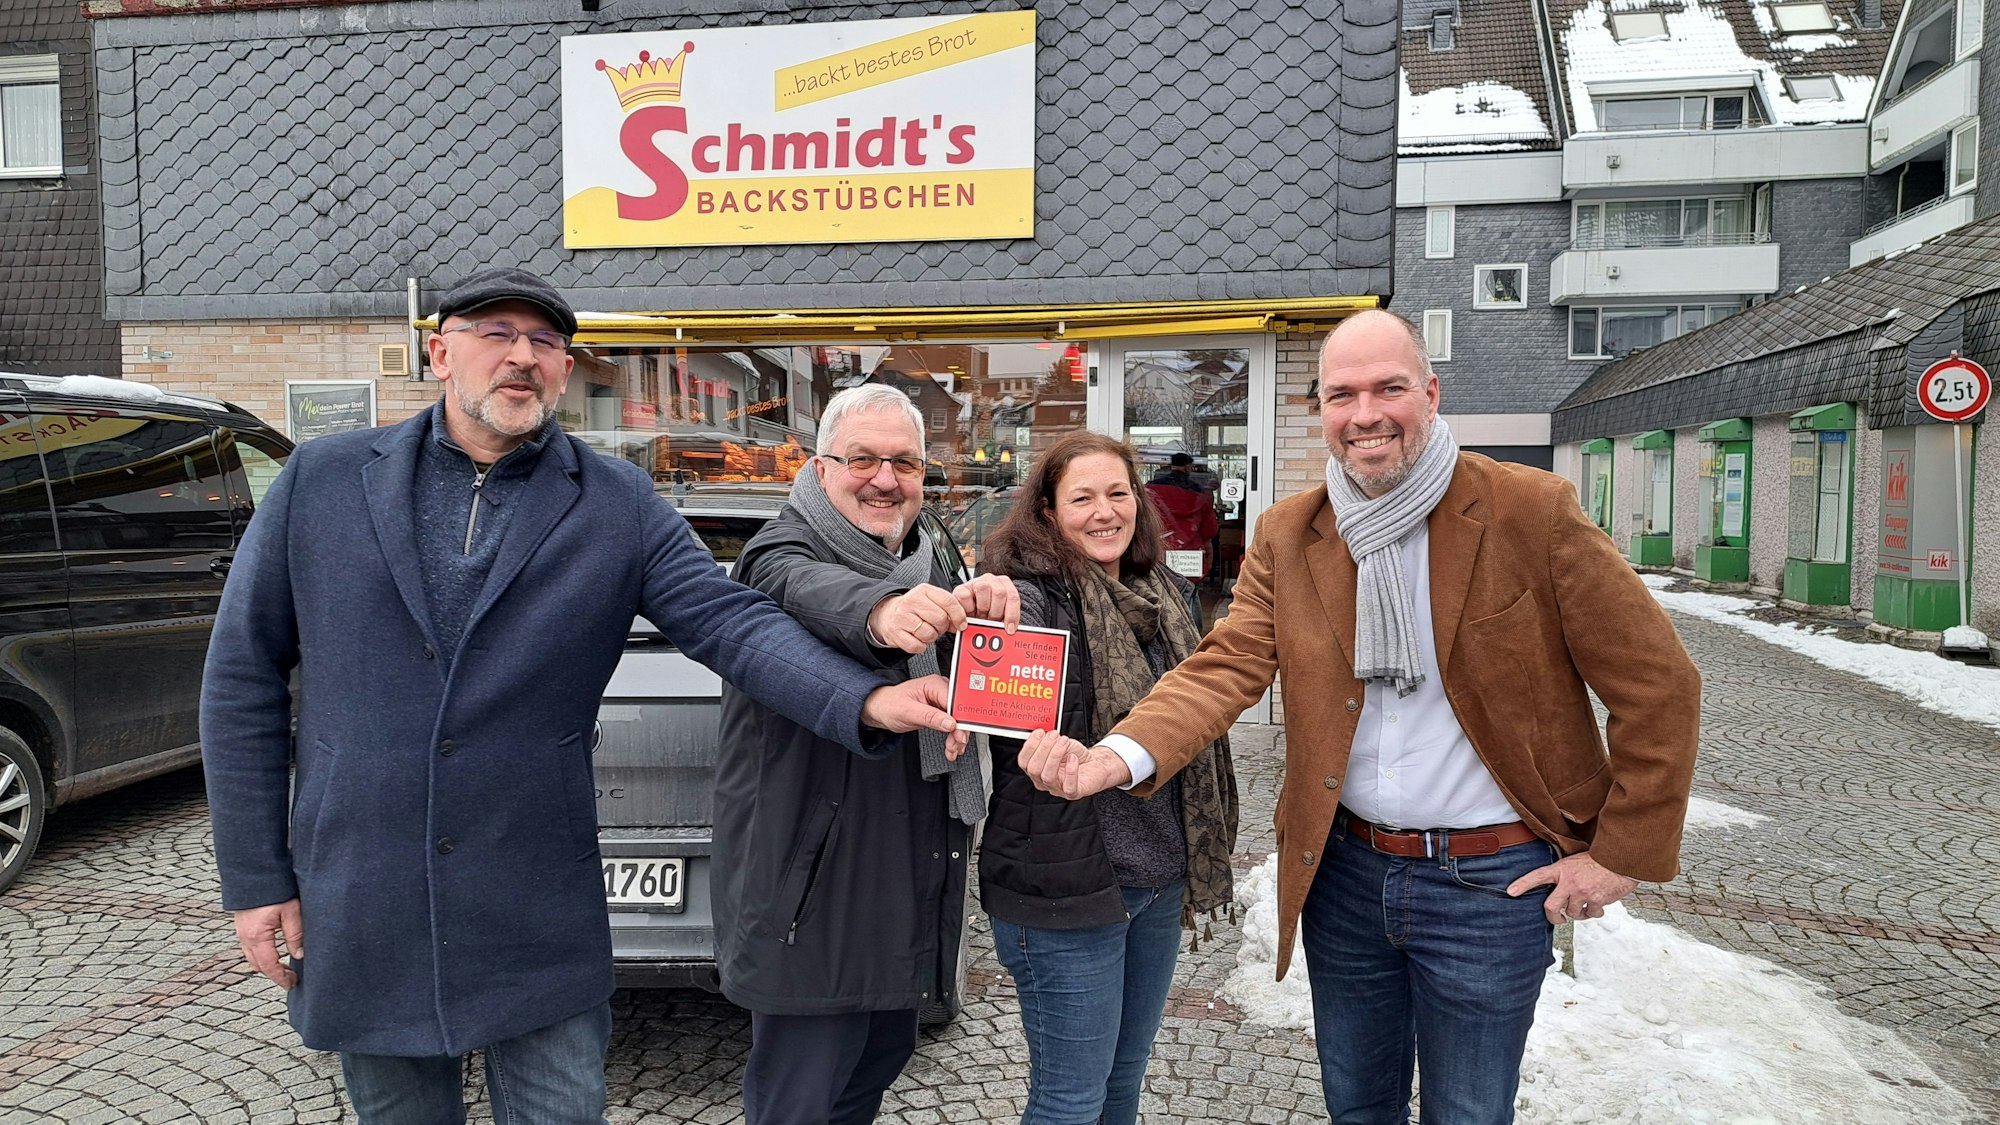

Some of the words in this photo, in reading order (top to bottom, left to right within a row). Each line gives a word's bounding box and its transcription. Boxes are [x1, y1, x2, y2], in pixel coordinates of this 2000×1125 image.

[782, 64, 852, 98] ...backt
[855, 44, 925, 78] bestes
[929, 27, 977, 57] Brot
[616, 105, 976, 221] Schmidt's
[697, 180, 976, 214] BACKSTÜBCHEN
[1930, 554, 1948, 568] kik
[1014, 640, 1031, 649] Hier
[1032, 642, 1058, 652] finden
[1025, 651, 1038, 660] Sie
[1040, 653, 1057, 661] eine
[1010, 664, 1055, 681] nette
[989, 676, 1053, 699] Toilette
[957, 704, 998, 717] Gemeinde
[1000, 709, 1051, 723] Marienheide
[991, 699, 1008, 709] Eine
[1010, 700, 1036, 712] Aktion
[1038, 704, 1052, 713] der
[603, 863, 678, 898] 1760
